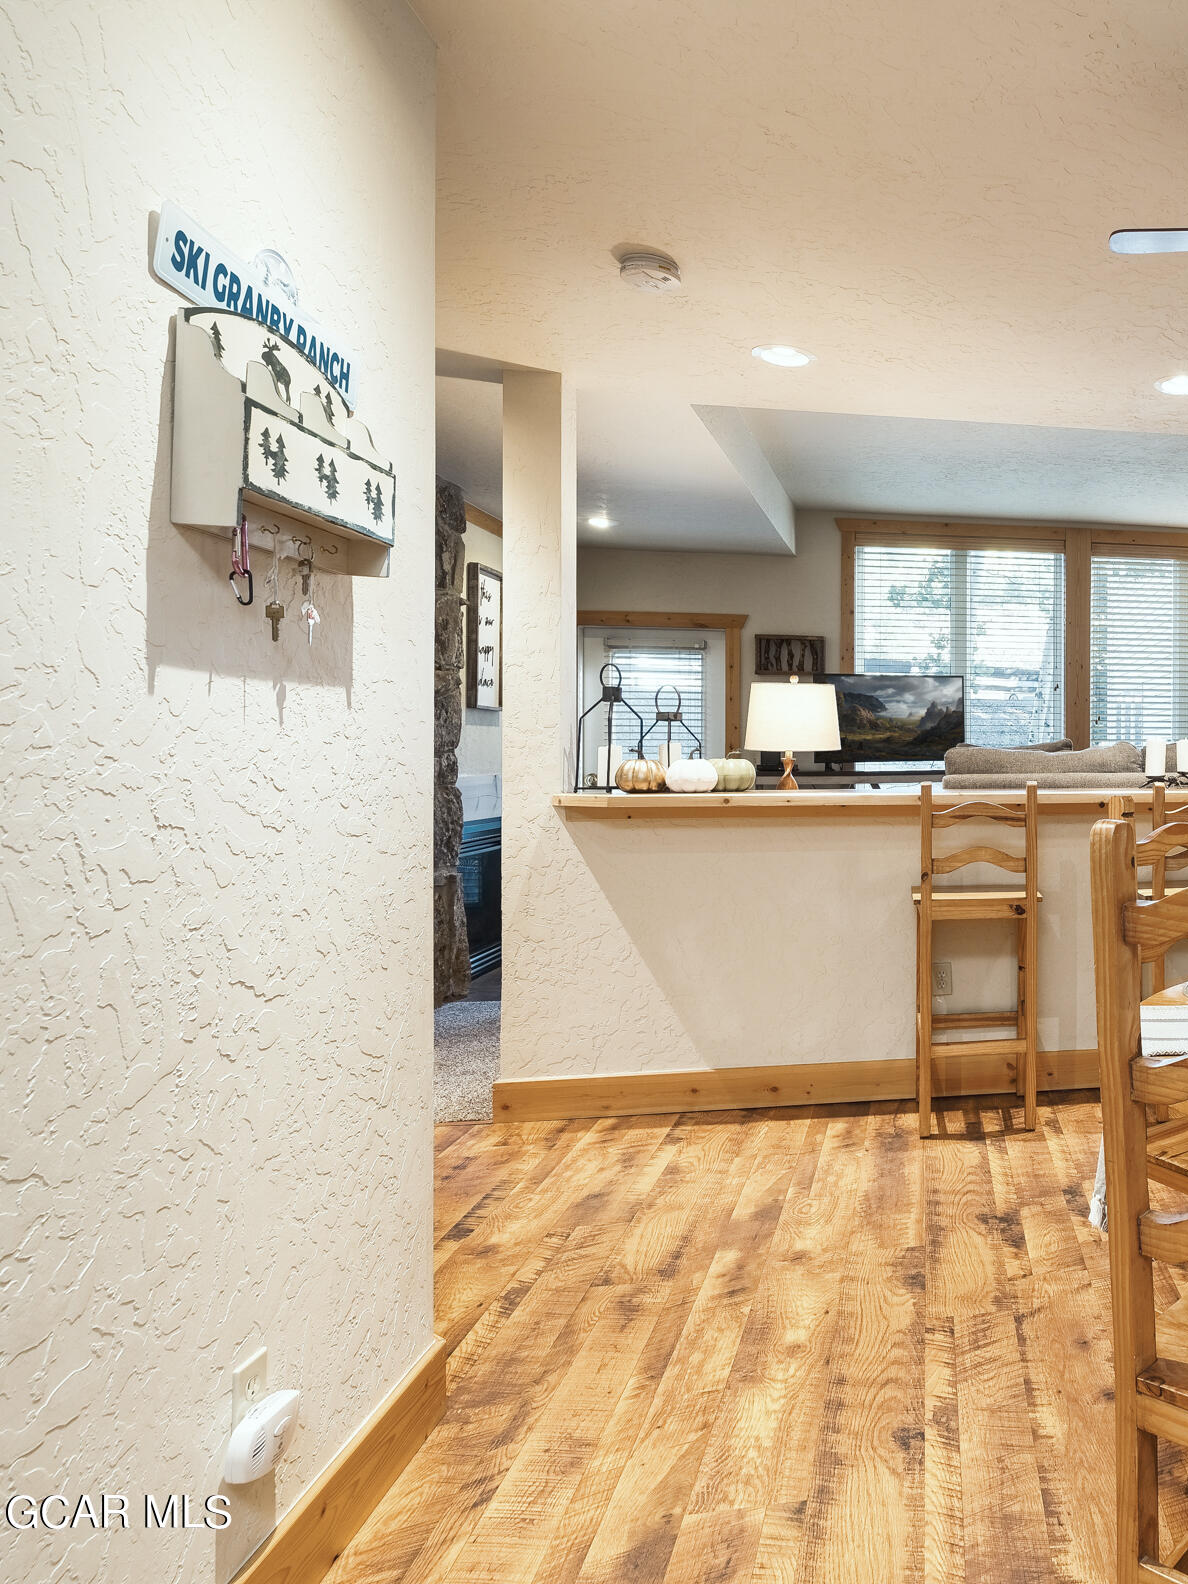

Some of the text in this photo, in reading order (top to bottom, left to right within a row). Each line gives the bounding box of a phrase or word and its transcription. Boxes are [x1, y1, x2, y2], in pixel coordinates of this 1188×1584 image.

[171, 230, 350, 393] SKI GRANBY RANCH
